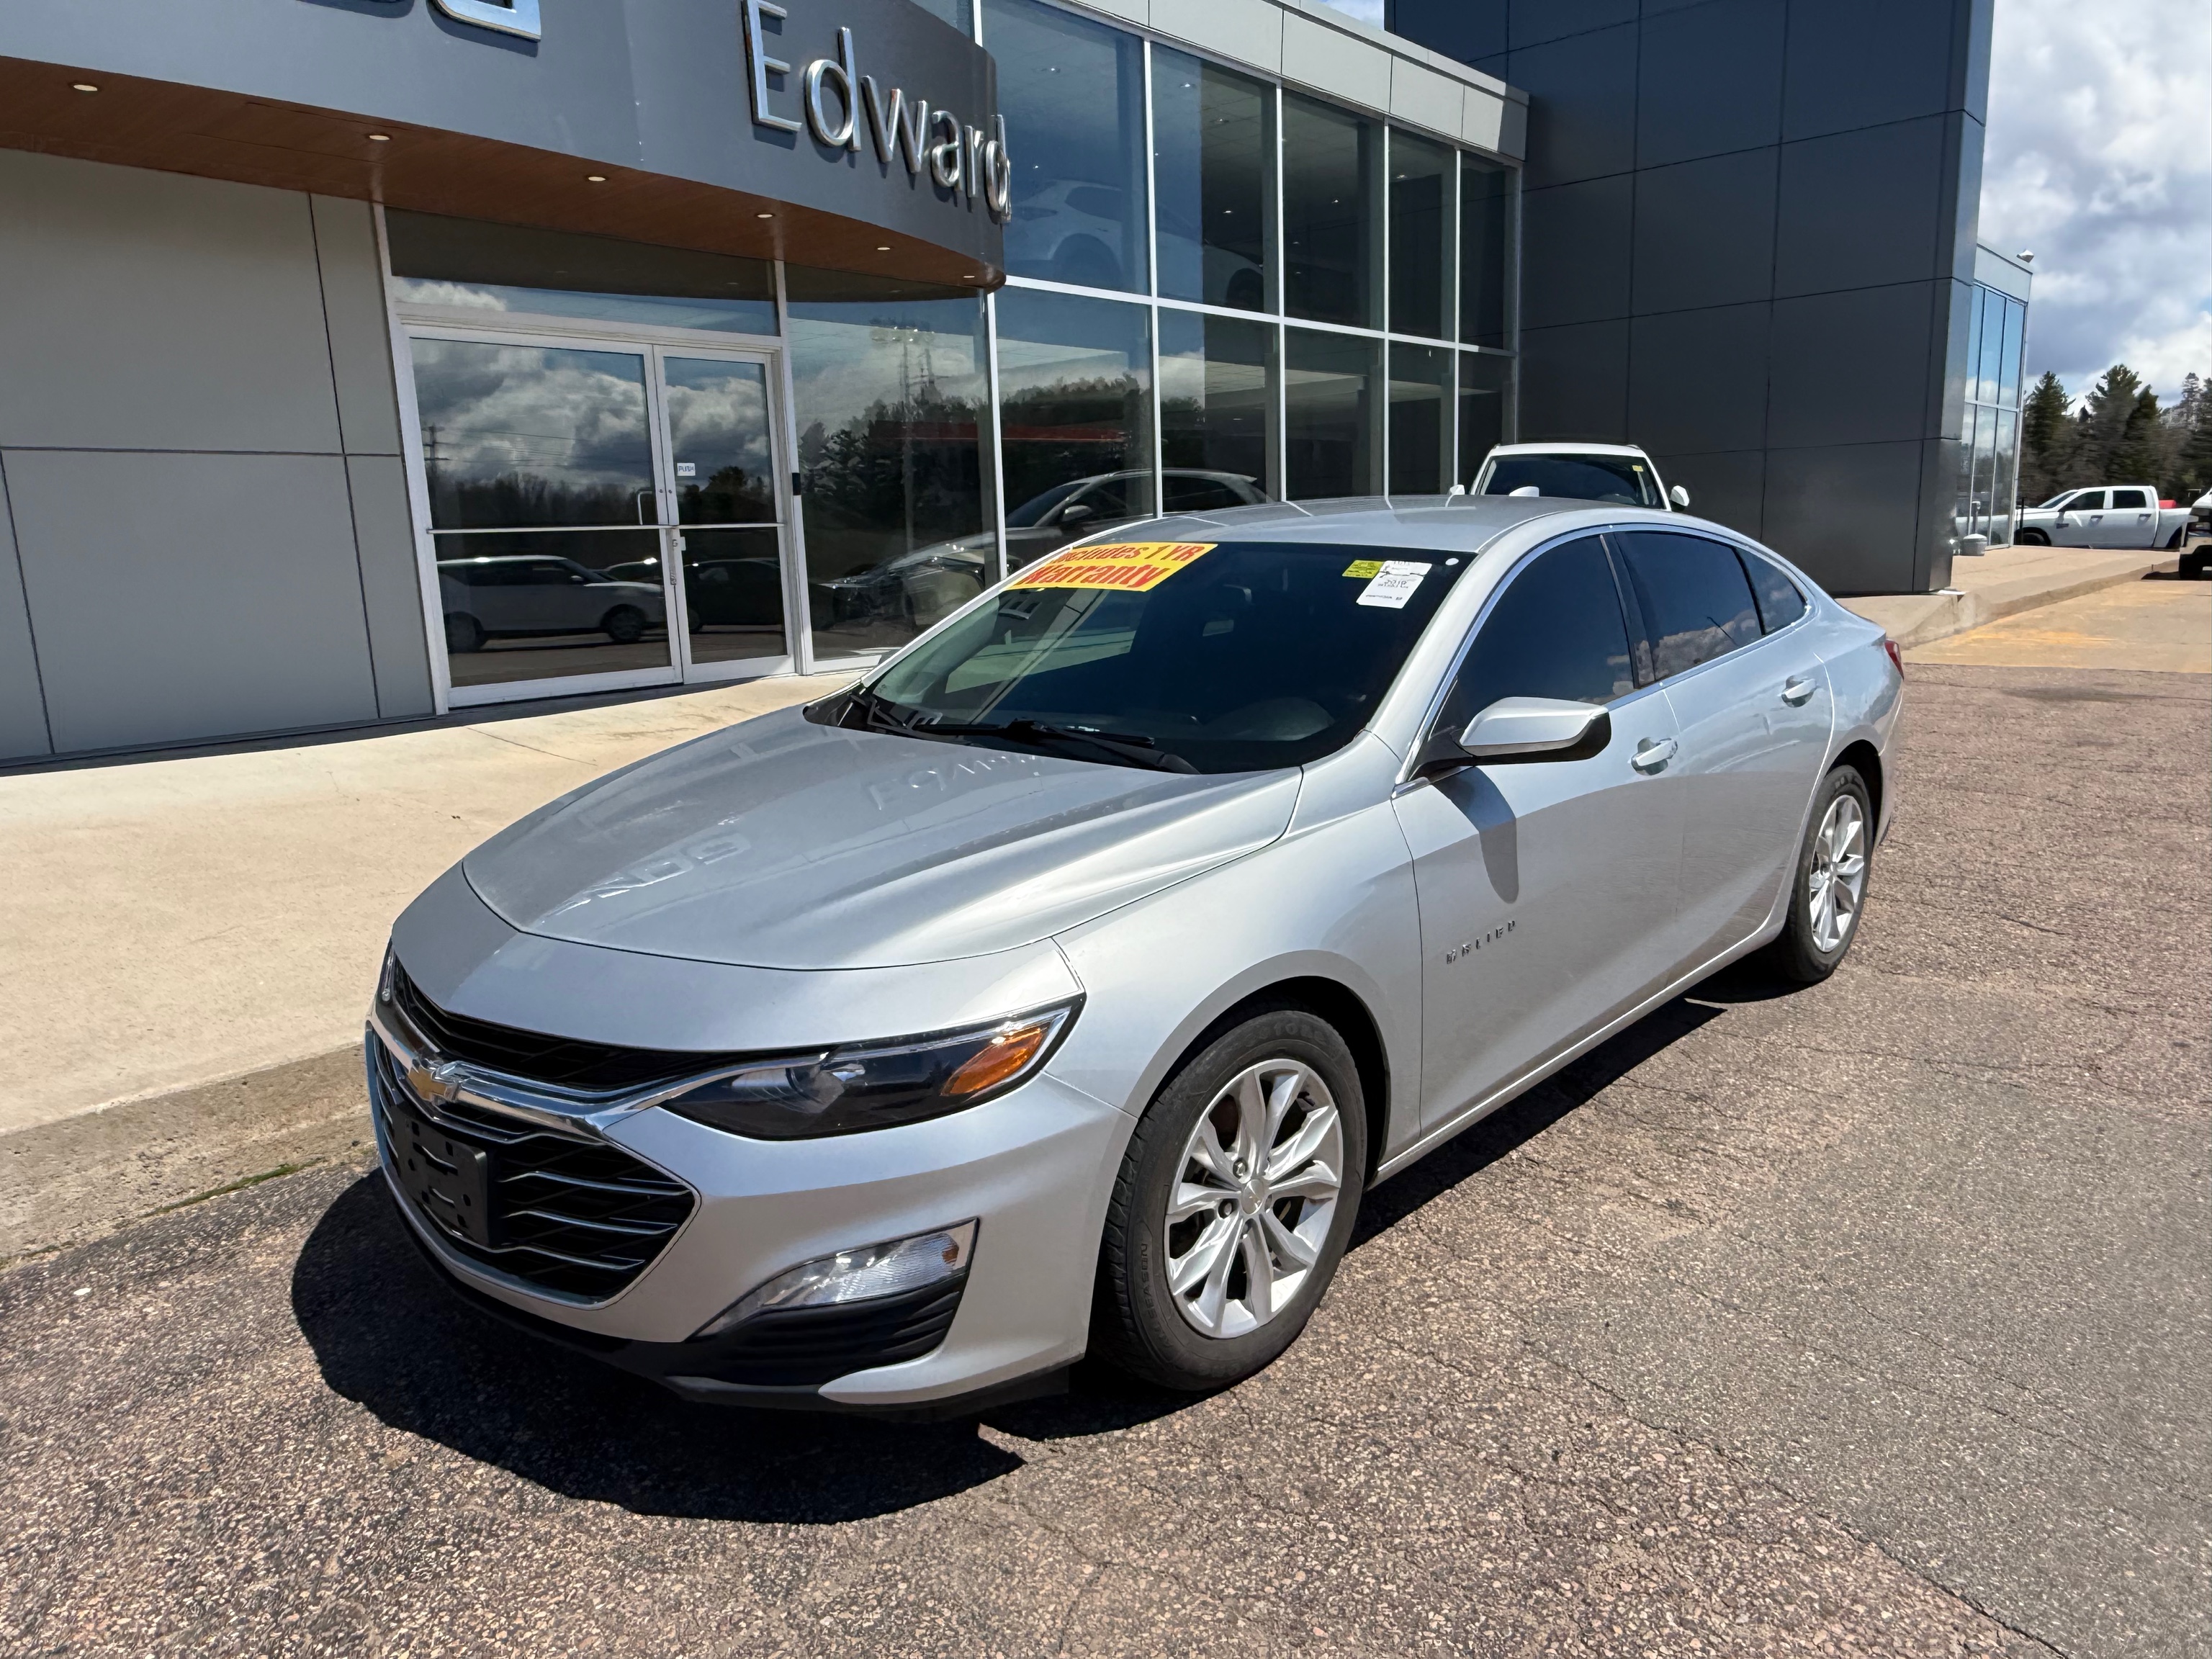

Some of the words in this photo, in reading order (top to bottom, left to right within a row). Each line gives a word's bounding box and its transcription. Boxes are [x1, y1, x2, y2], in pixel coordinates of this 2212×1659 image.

[742, 0, 1011, 222] Edward
[1144, 545, 1170, 559] 1
[1160, 545, 1205, 561] YR
[1014, 564, 1170, 588] Warranty
